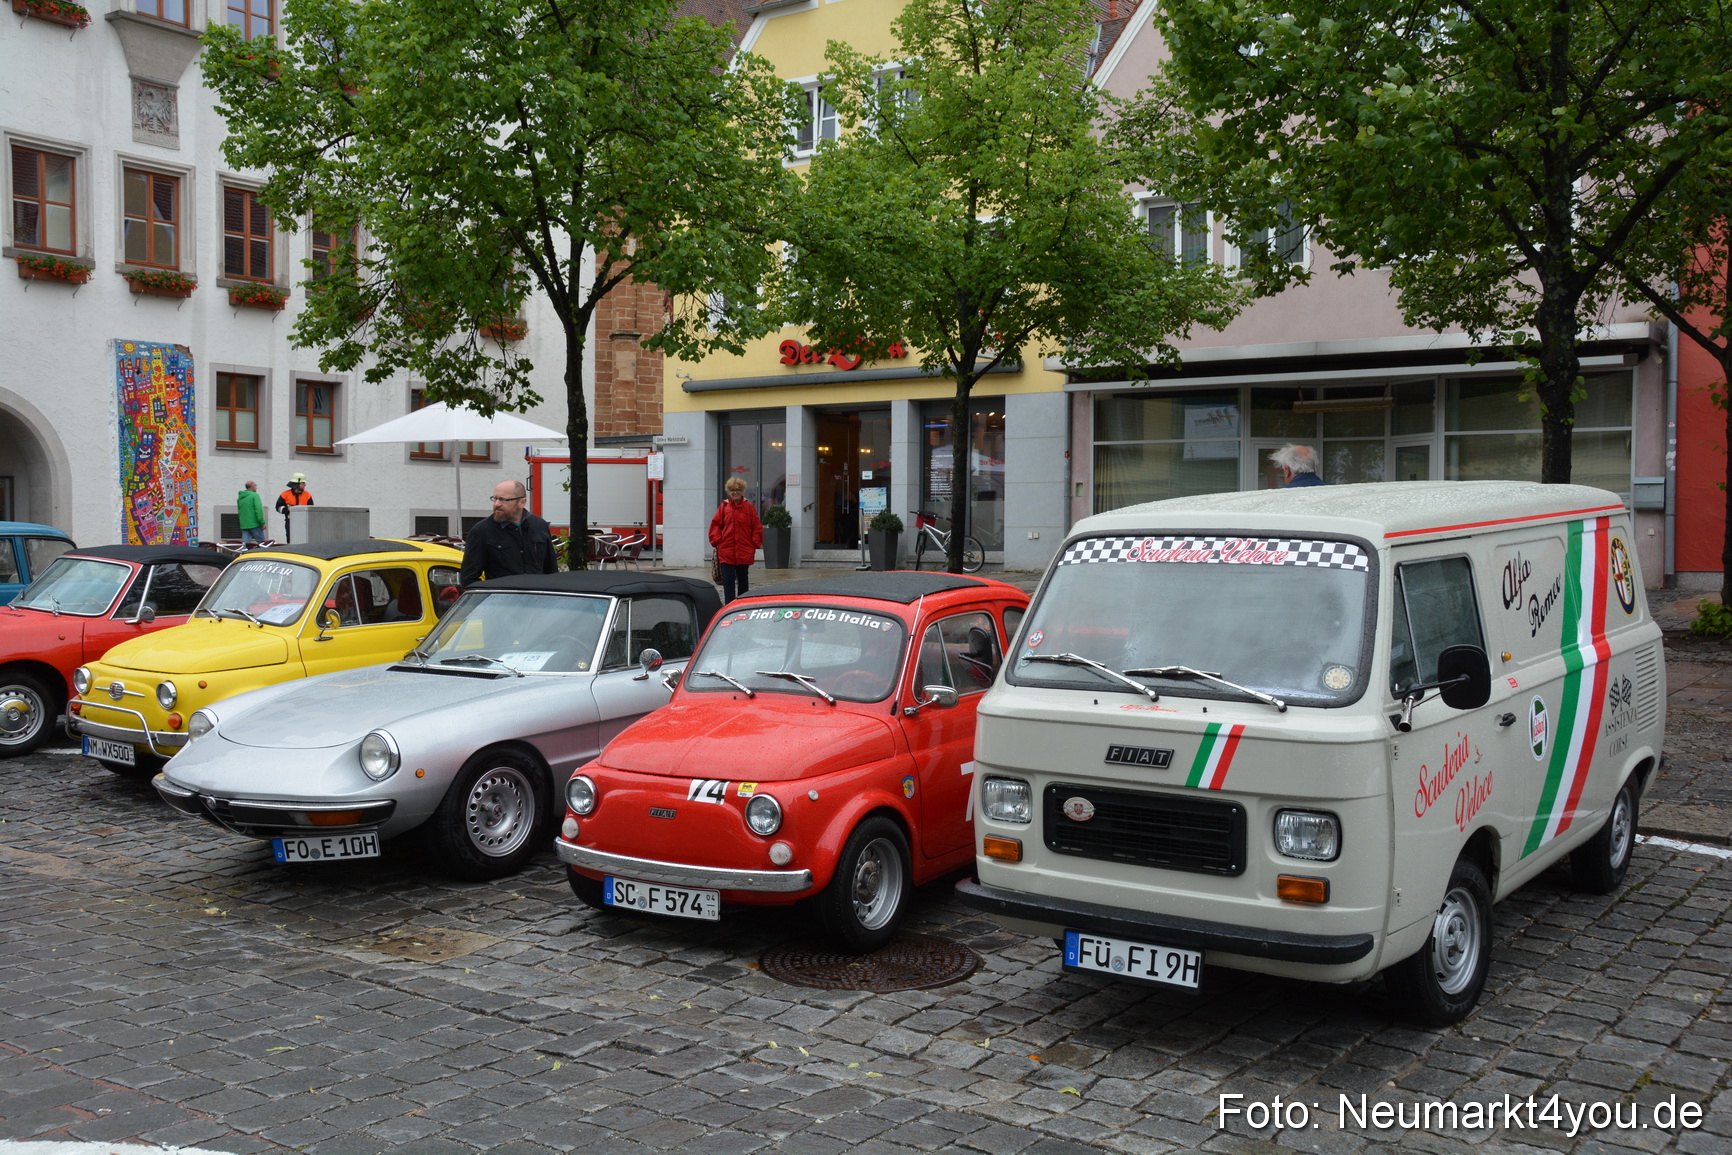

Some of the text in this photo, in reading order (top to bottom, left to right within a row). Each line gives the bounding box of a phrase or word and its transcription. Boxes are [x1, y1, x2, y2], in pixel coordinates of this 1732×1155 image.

[1126, 538, 1289, 563] Scuderia Veloce
[750, 609, 775, 620] Fiat
[804, 609, 836, 621] Club
[838, 611, 881, 629] Italia
[1528, 594, 1561, 638] Romeo
[88, 738, 97, 755] NM
[1110, 748, 1167, 764] FIAT
[1414, 731, 1470, 818] Scuderia
[1455, 770, 1494, 832] Veloce
[649, 807, 675, 819] FIAT
[284, 840, 309, 859] FO
[614, 881, 637, 905] SC
[665, 889, 703, 915] 574
[707, 909, 716, 917] 10
[1069, 951, 1075, 960] D
[1079, 937, 1111, 969] FÜ
